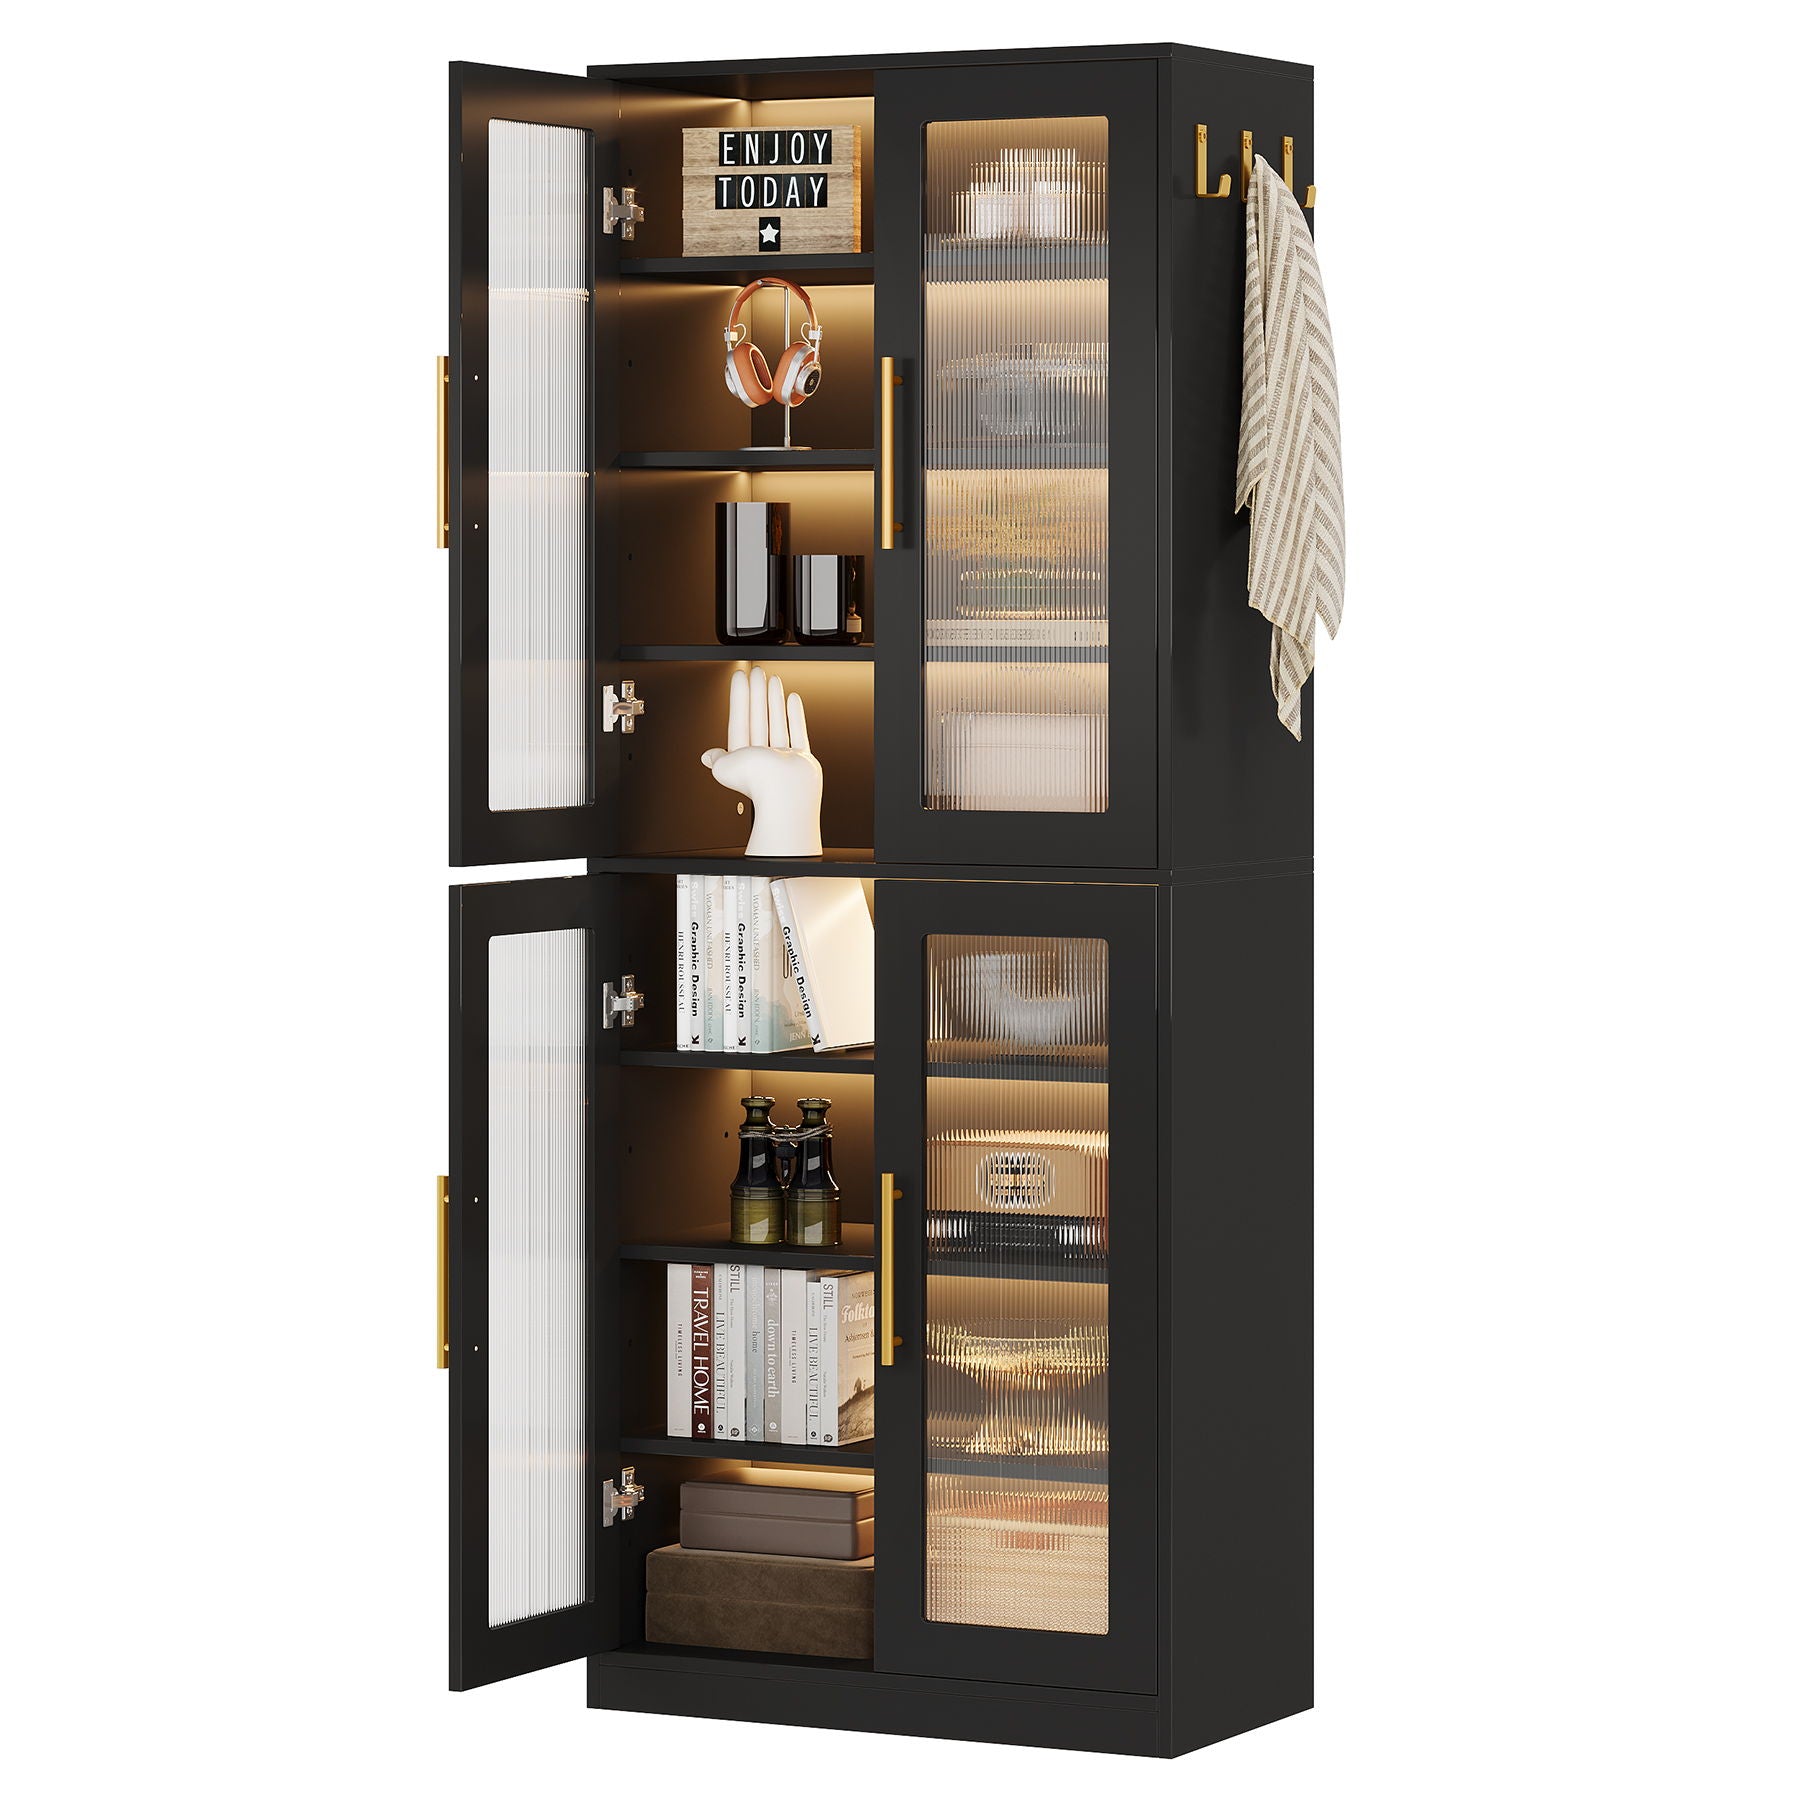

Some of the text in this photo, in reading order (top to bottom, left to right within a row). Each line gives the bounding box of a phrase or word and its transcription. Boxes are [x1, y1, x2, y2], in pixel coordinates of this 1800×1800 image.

[723, 132, 828, 165] ENJOY
[718, 176, 824, 208] TODAY
[690, 921, 700, 970] Graphic
[737, 922, 746, 972] Graphic
[783, 926, 799, 973] Graphic
[796, 976, 812, 1018] Design
[691, 974, 700, 1017] Design
[738, 976, 747, 1018] Design
[730, 1264, 741, 1294] STILL
[823, 1284, 834, 1311] STILL
[693, 1287, 709, 1351] TRAVEL
[752, 1331, 761, 1353] home
[809, 1327, 818, 1354] LIVE
[716, 1312, 725, 1413] LIVE BEAUTIFUL
[767, 1319, 780, 1398] down to earth
[693, 1356, 709, 1415] HOME
[809, 1357, 818, 1421] BEAUTIFUL
